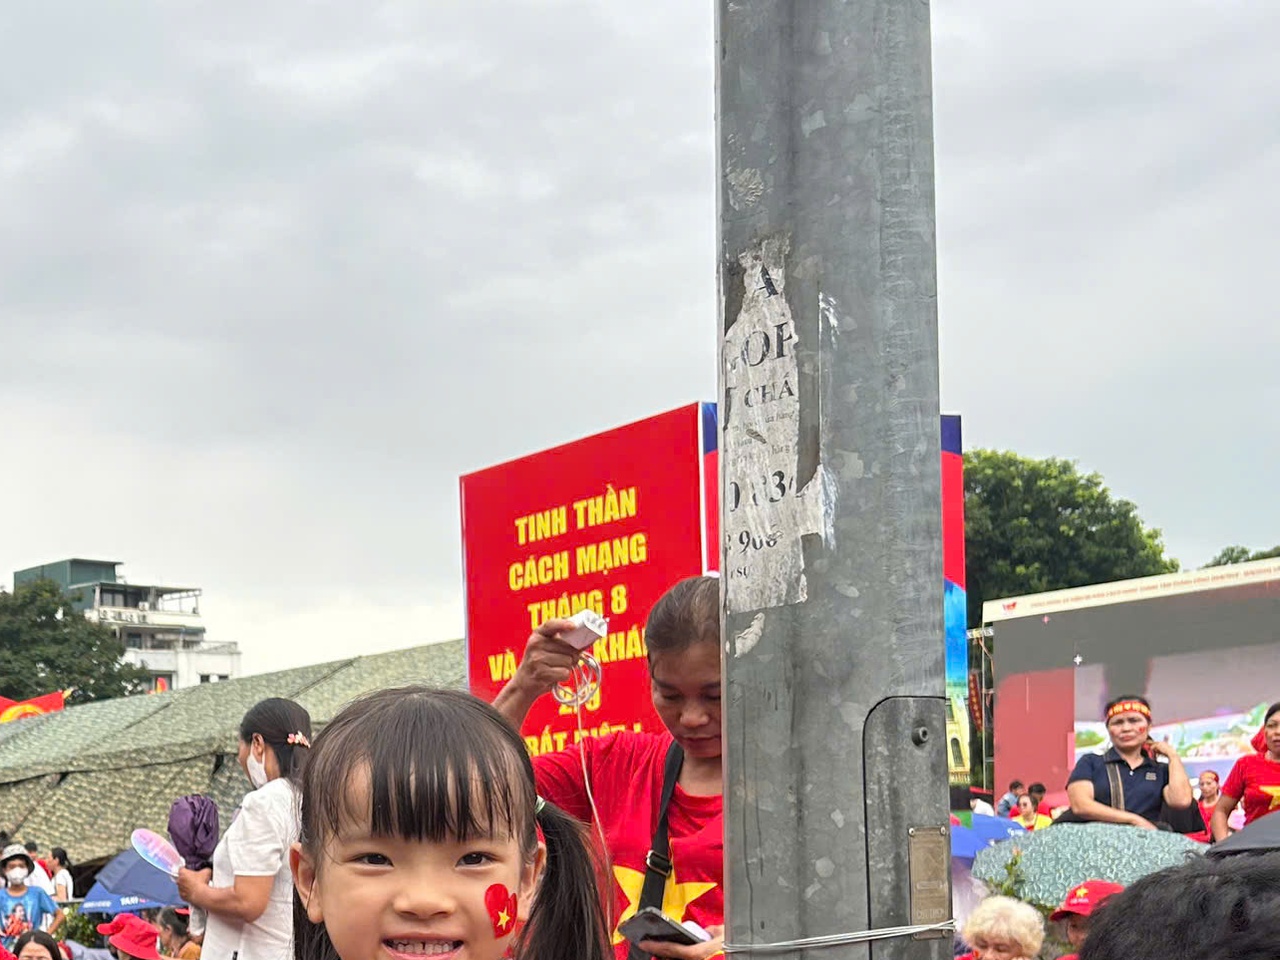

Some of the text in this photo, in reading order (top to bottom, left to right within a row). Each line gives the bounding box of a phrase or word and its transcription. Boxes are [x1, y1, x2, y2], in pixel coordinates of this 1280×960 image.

[514, 484, 637, 545] TINH THẦN
[508, 532, 647, 591] CÁCH MẠNG
[610, 584, 627, 615] 8
[488, 624, 647, 682] VÀ KHÁ
